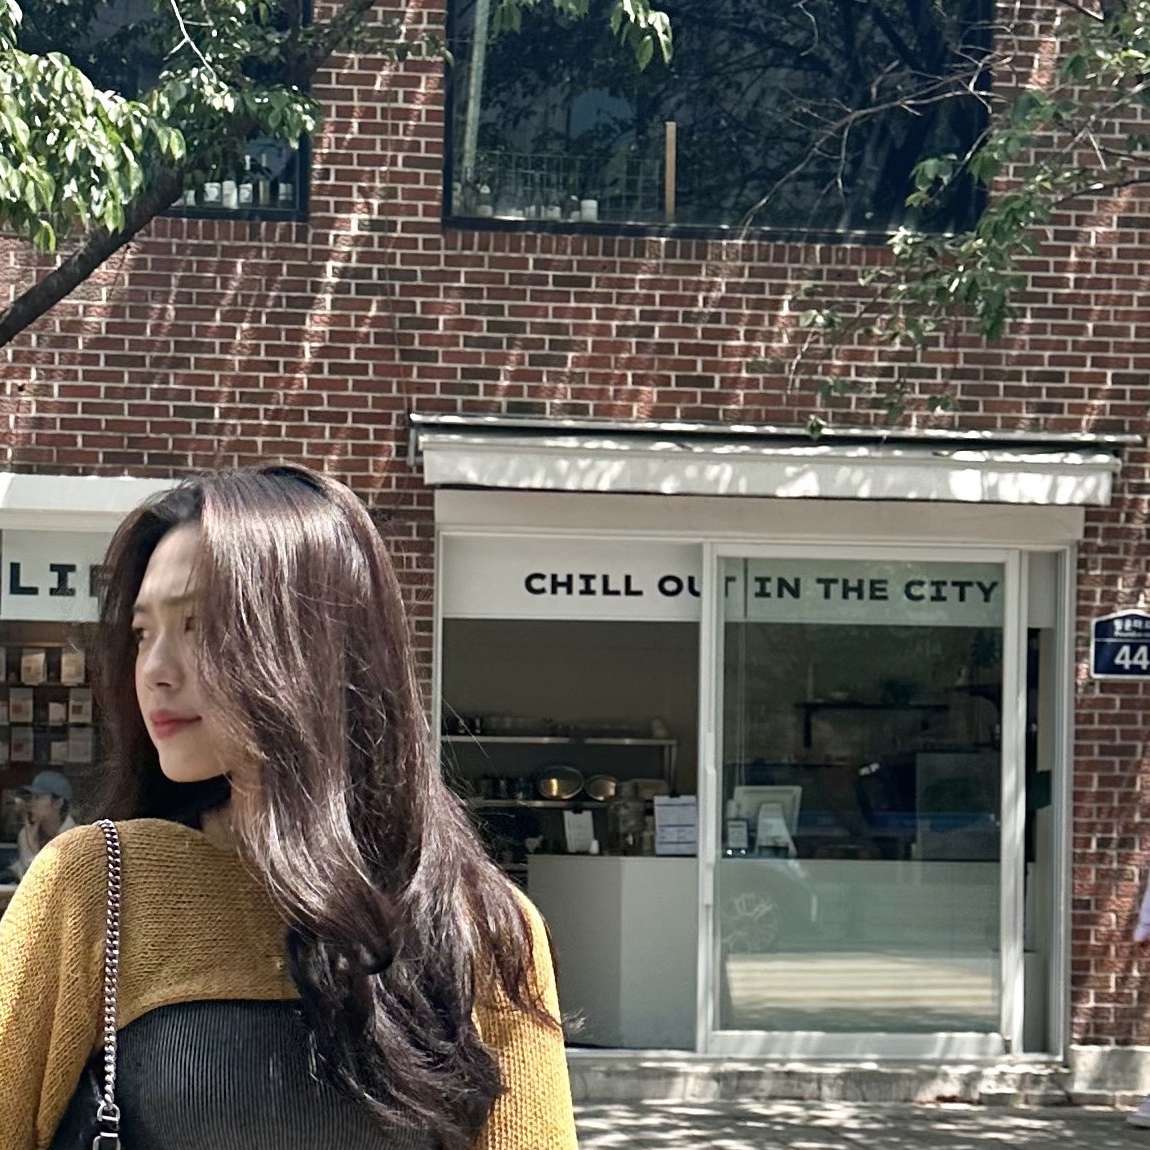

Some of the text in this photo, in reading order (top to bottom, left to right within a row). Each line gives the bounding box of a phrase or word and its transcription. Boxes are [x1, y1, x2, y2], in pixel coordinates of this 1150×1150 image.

[524, 573, 643, 596] CHILL
[754, 577, 800, 598] IN
[816, 577, 889, 601] THE
[904, 580, 998, 602] CITY
[1114, 644, 1150, 670] 44
